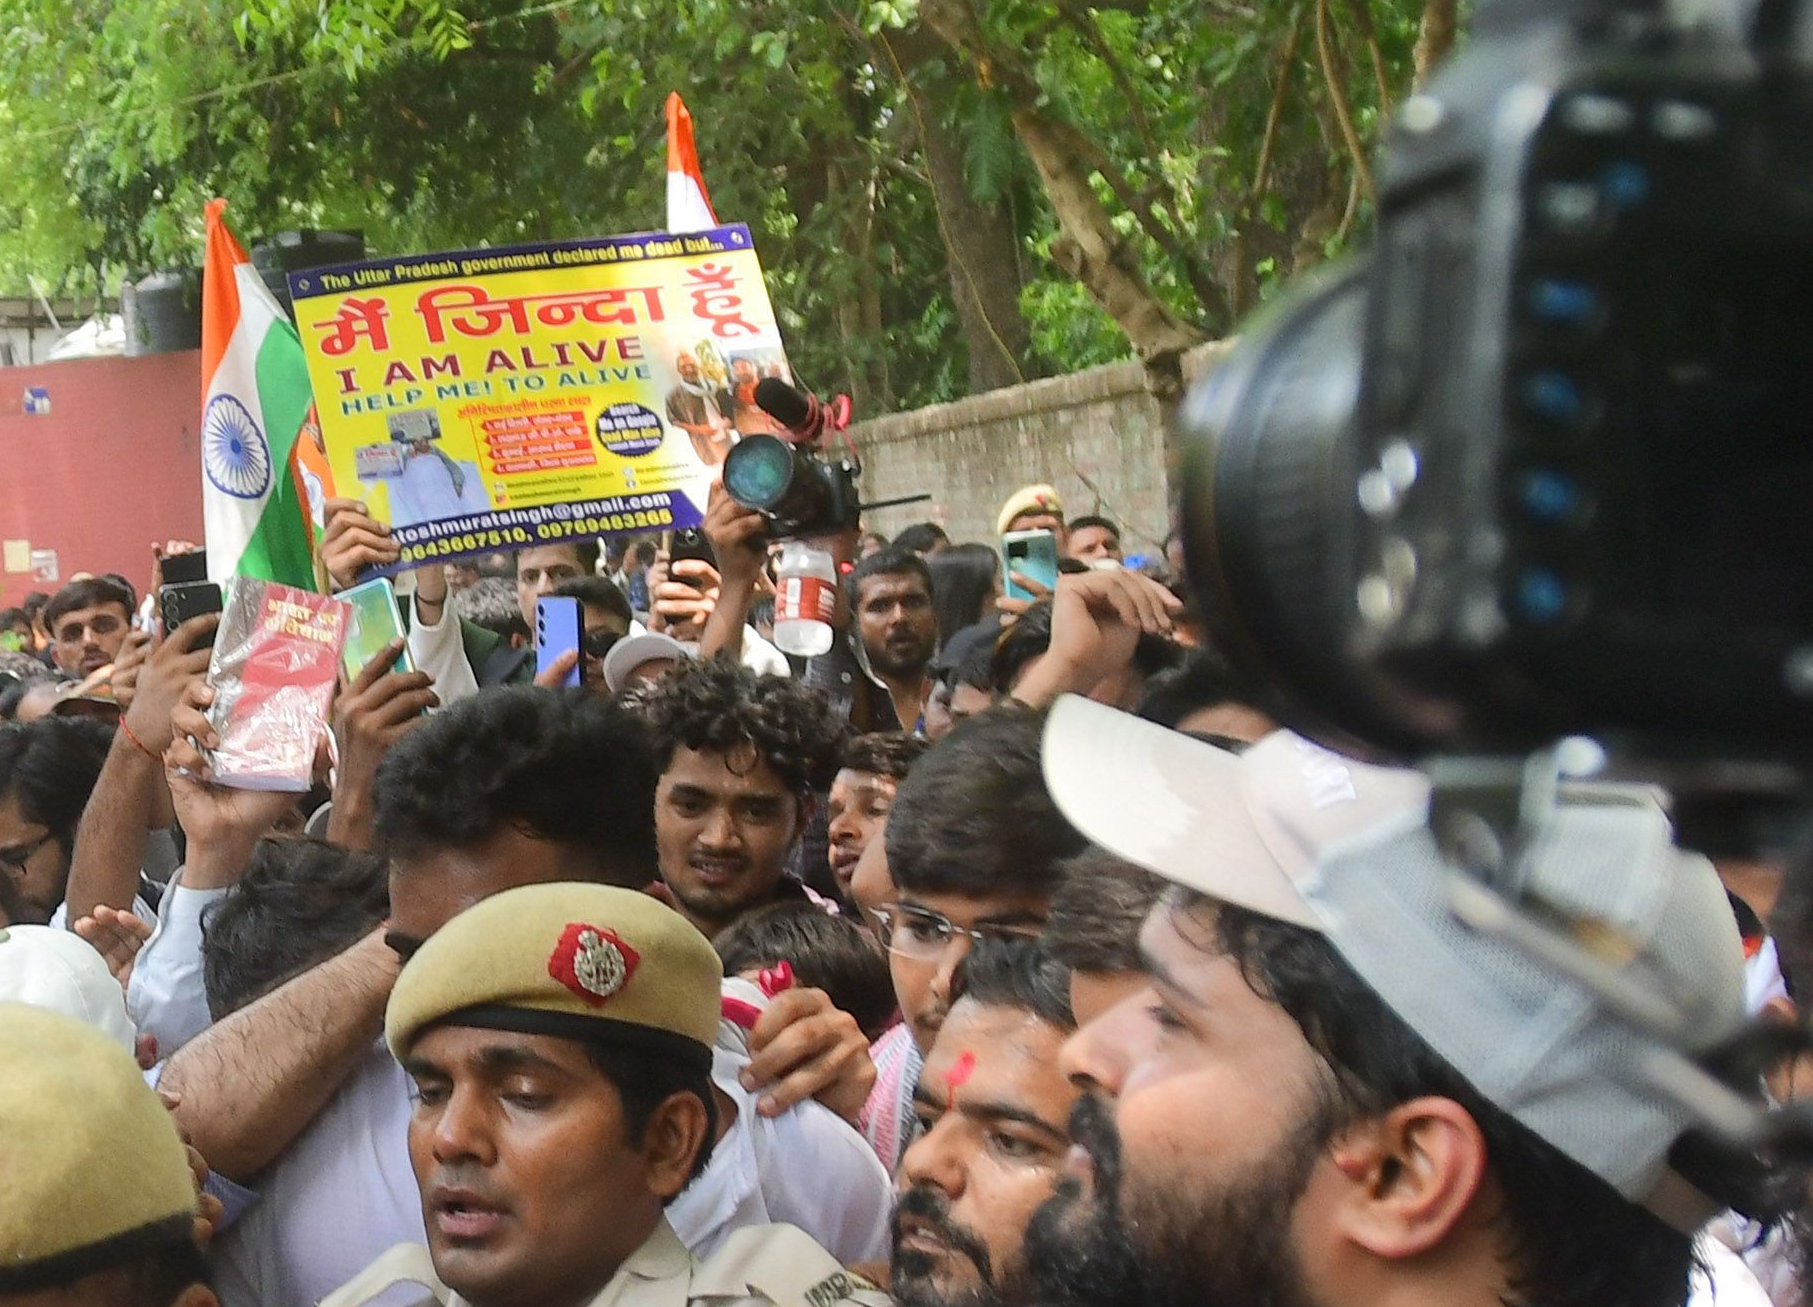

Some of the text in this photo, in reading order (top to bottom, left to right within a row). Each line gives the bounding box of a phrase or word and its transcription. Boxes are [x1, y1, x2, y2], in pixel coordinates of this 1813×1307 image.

[320, 273, 351, 291] The
[353, 268, 391, 286] Uttar
[393, 259, 459, 280] Pradesh
[461, 250, 551, 276] government
[552, 243, 617, 264] declared
[619, 243, 644, 260] me
[645, 238, 684, 257] dead
[313, 262, 761, 357] मैं जिन्दा हूँ
[335, 335, 646, 395] I AM ALIVE
[341, 364, 653, 417] HELP ME! TO ALIVE
